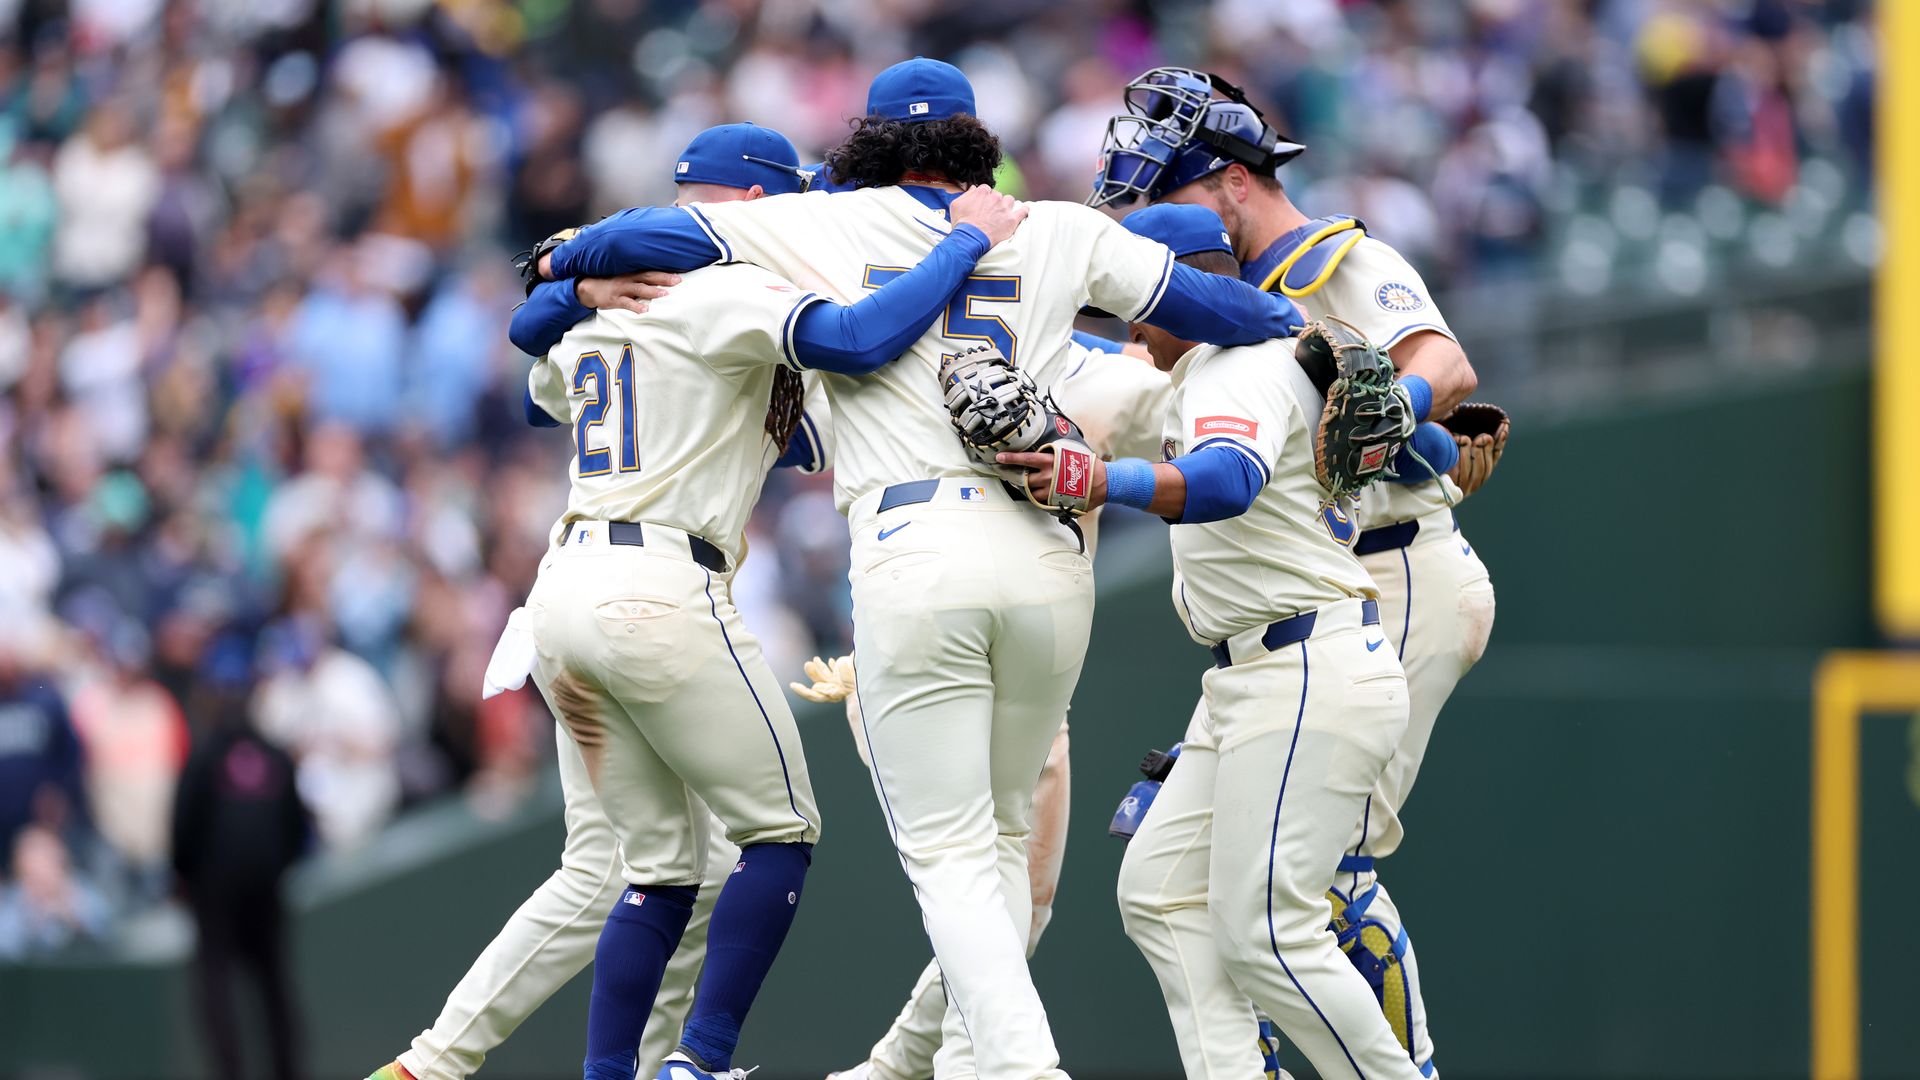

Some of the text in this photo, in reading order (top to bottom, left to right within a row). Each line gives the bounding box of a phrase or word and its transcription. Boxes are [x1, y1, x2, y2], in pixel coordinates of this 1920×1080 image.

[862, 264, 1021, 370] 5
[572, 343, 641, 478] 21
[1067, 454, 1080, 492] Rawlings
